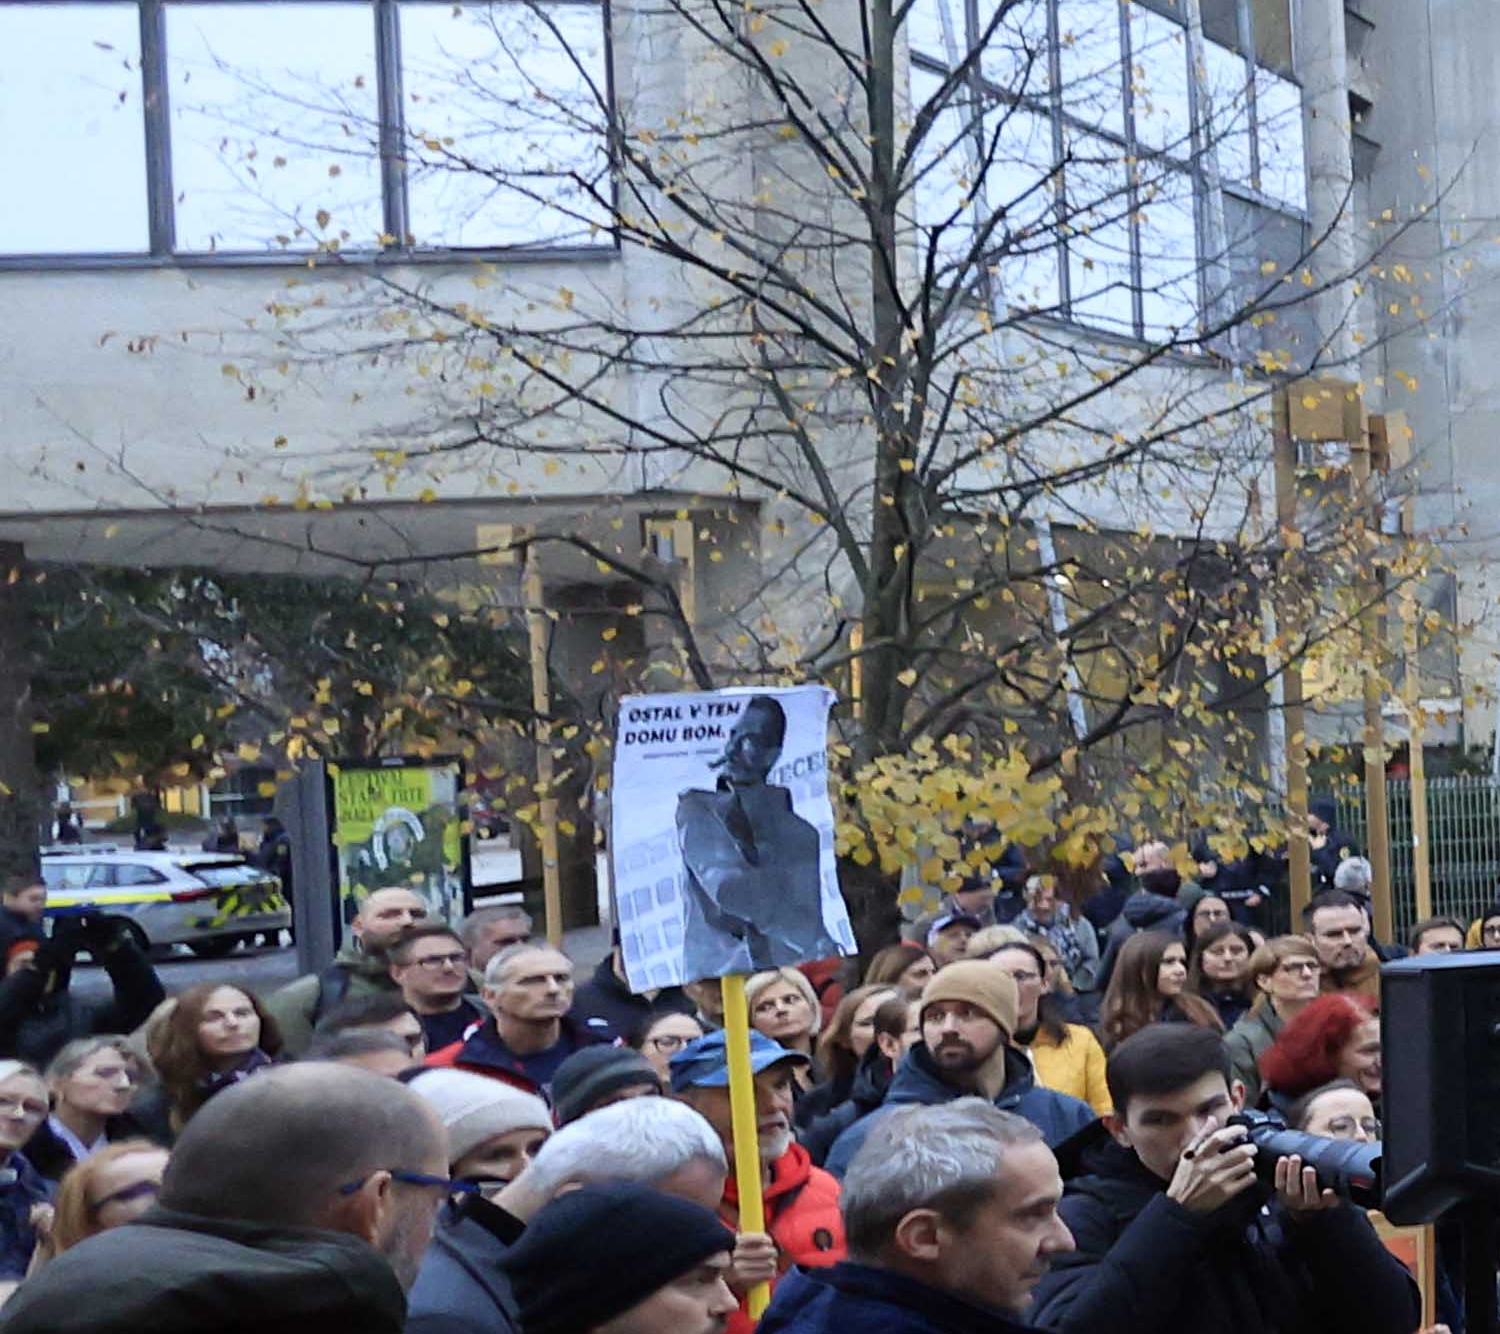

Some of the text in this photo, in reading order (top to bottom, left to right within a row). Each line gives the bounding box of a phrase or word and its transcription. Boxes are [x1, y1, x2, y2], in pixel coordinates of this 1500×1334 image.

[628, 701, 741, 723] OSTAL V TEM
[624, 725, 726, 745] DOMU BOM.
